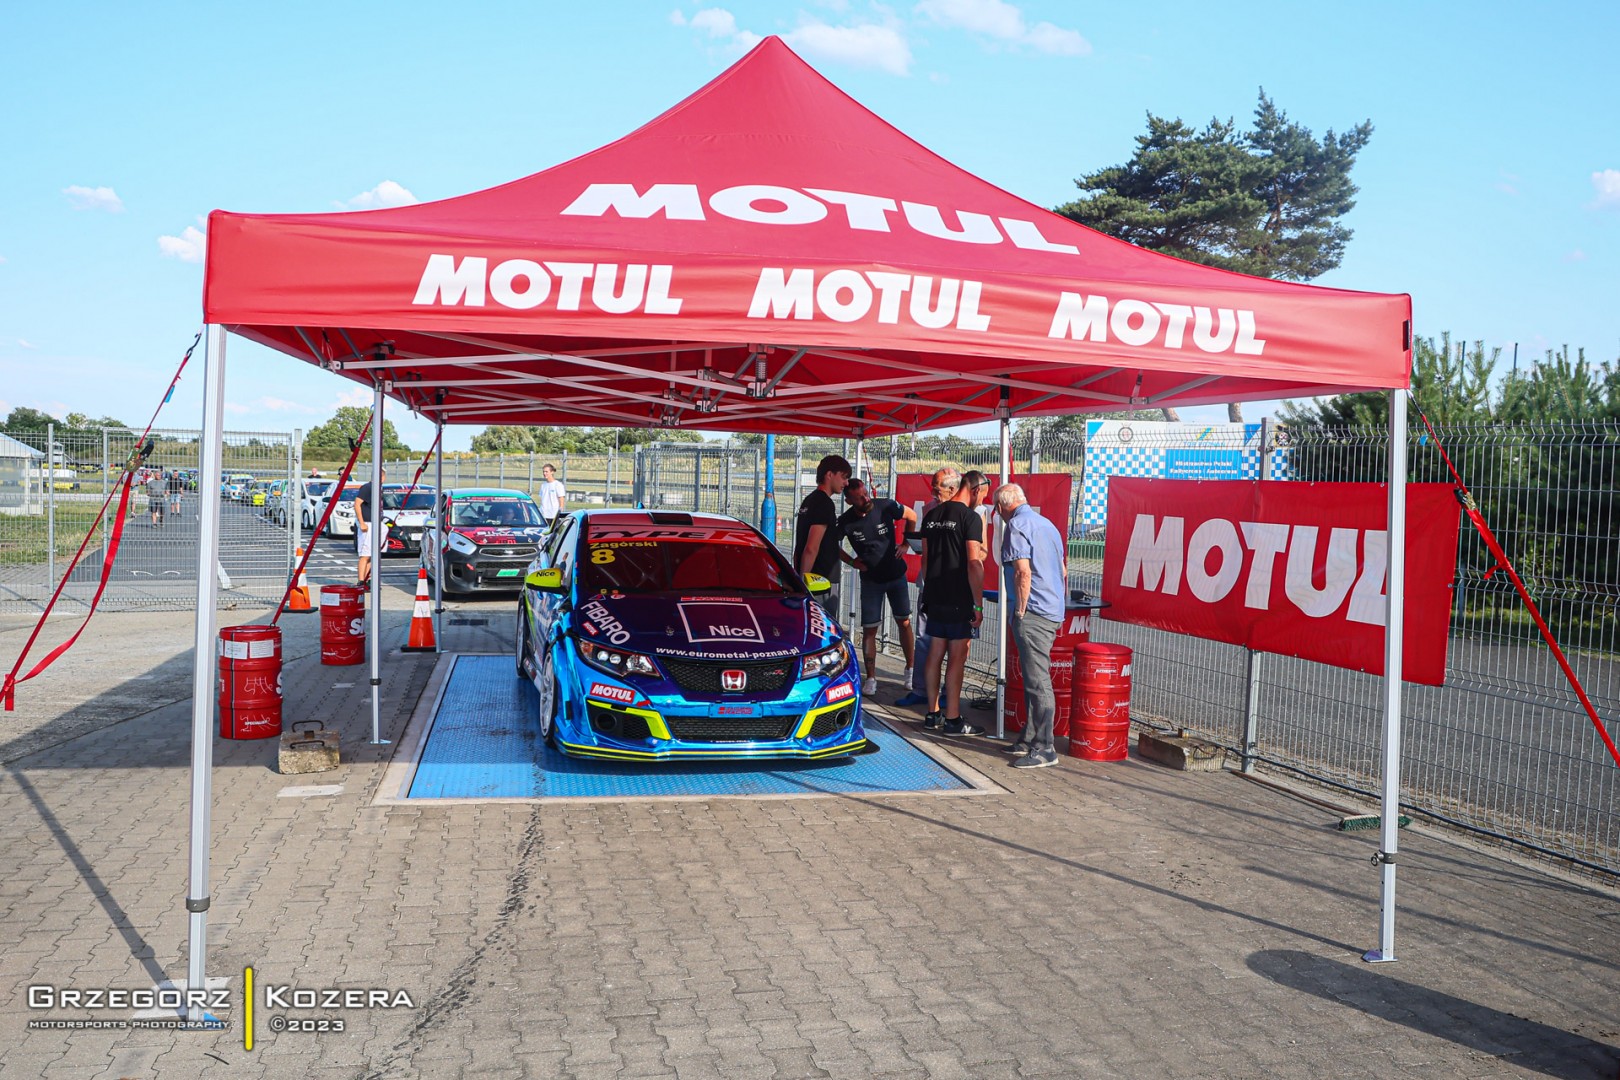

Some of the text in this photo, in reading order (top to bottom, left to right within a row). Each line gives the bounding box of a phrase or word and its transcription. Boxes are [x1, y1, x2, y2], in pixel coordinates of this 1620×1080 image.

[560, 183, 1080, 255] MOTUL
[412, 254, 1266, 355] MOTUL MOTUL MOTUL
[590, 541, 657, 550] Zagórski
[590, 549, 616, 565] 8
[580, 600, 630, 645] FIBARO
[708, 625, 756, 638] Nice
[656, 646, 800, 660] www.eurometal-poznan.pl
[592, 684, 632, 701] MOTUL
[828, 684, 853, 701] MOTUL
